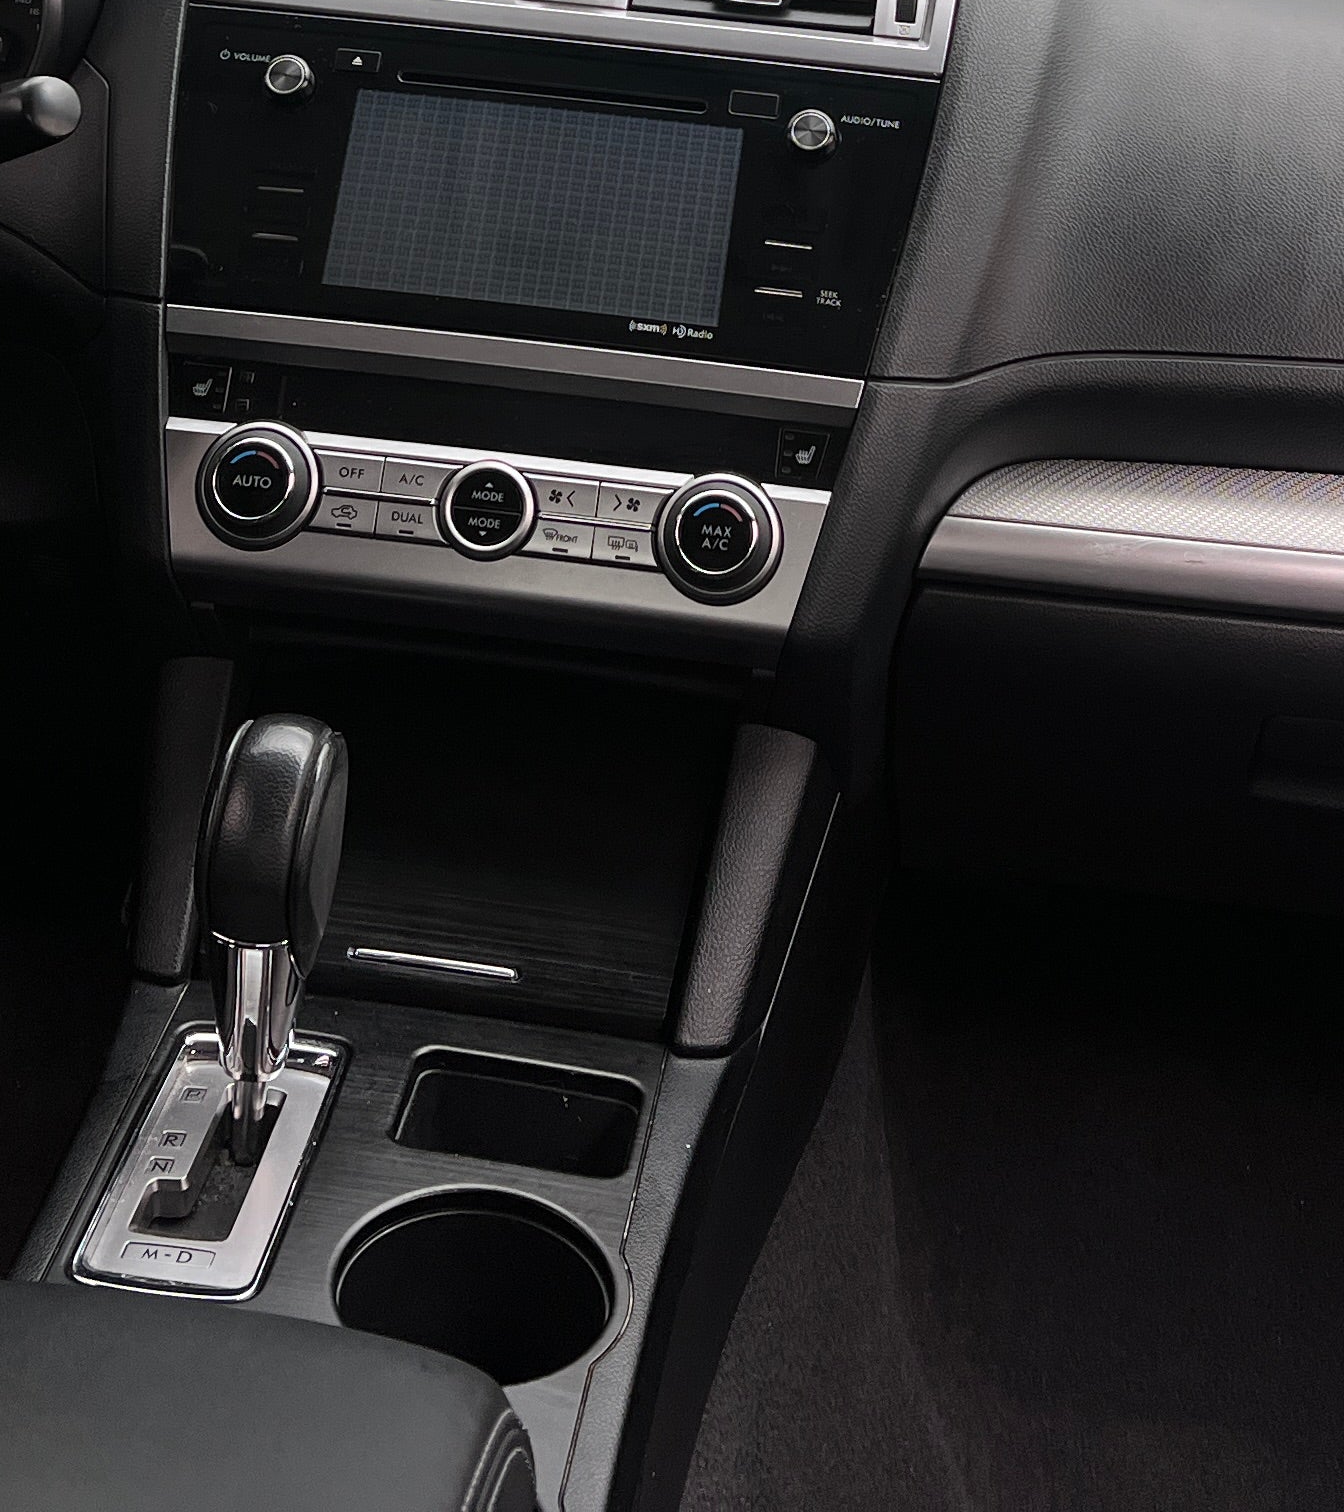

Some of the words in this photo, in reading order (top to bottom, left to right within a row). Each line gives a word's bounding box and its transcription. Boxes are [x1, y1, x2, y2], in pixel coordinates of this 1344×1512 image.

[233, 51, 272, 63] VOLUME
[840, 114, 902, 130] AUDIO/TUNE
[819, 289, 839, 299] SEEK
[816, 297, 842, 307] TRACK
[686, 328, 714, 340] Radio
[338, 466, 366, 480] OFF
[397, 472, 426, 487] A/C
[232, 474, 273, 489] AUTO
[470, 489, 505, 504] MODE
[390, 510, 424, 525] DUAL
[466, 516, 502, 530] MODE
[700, 523, 733, 539] MAX
[700, 537, 730, 551] A/C
